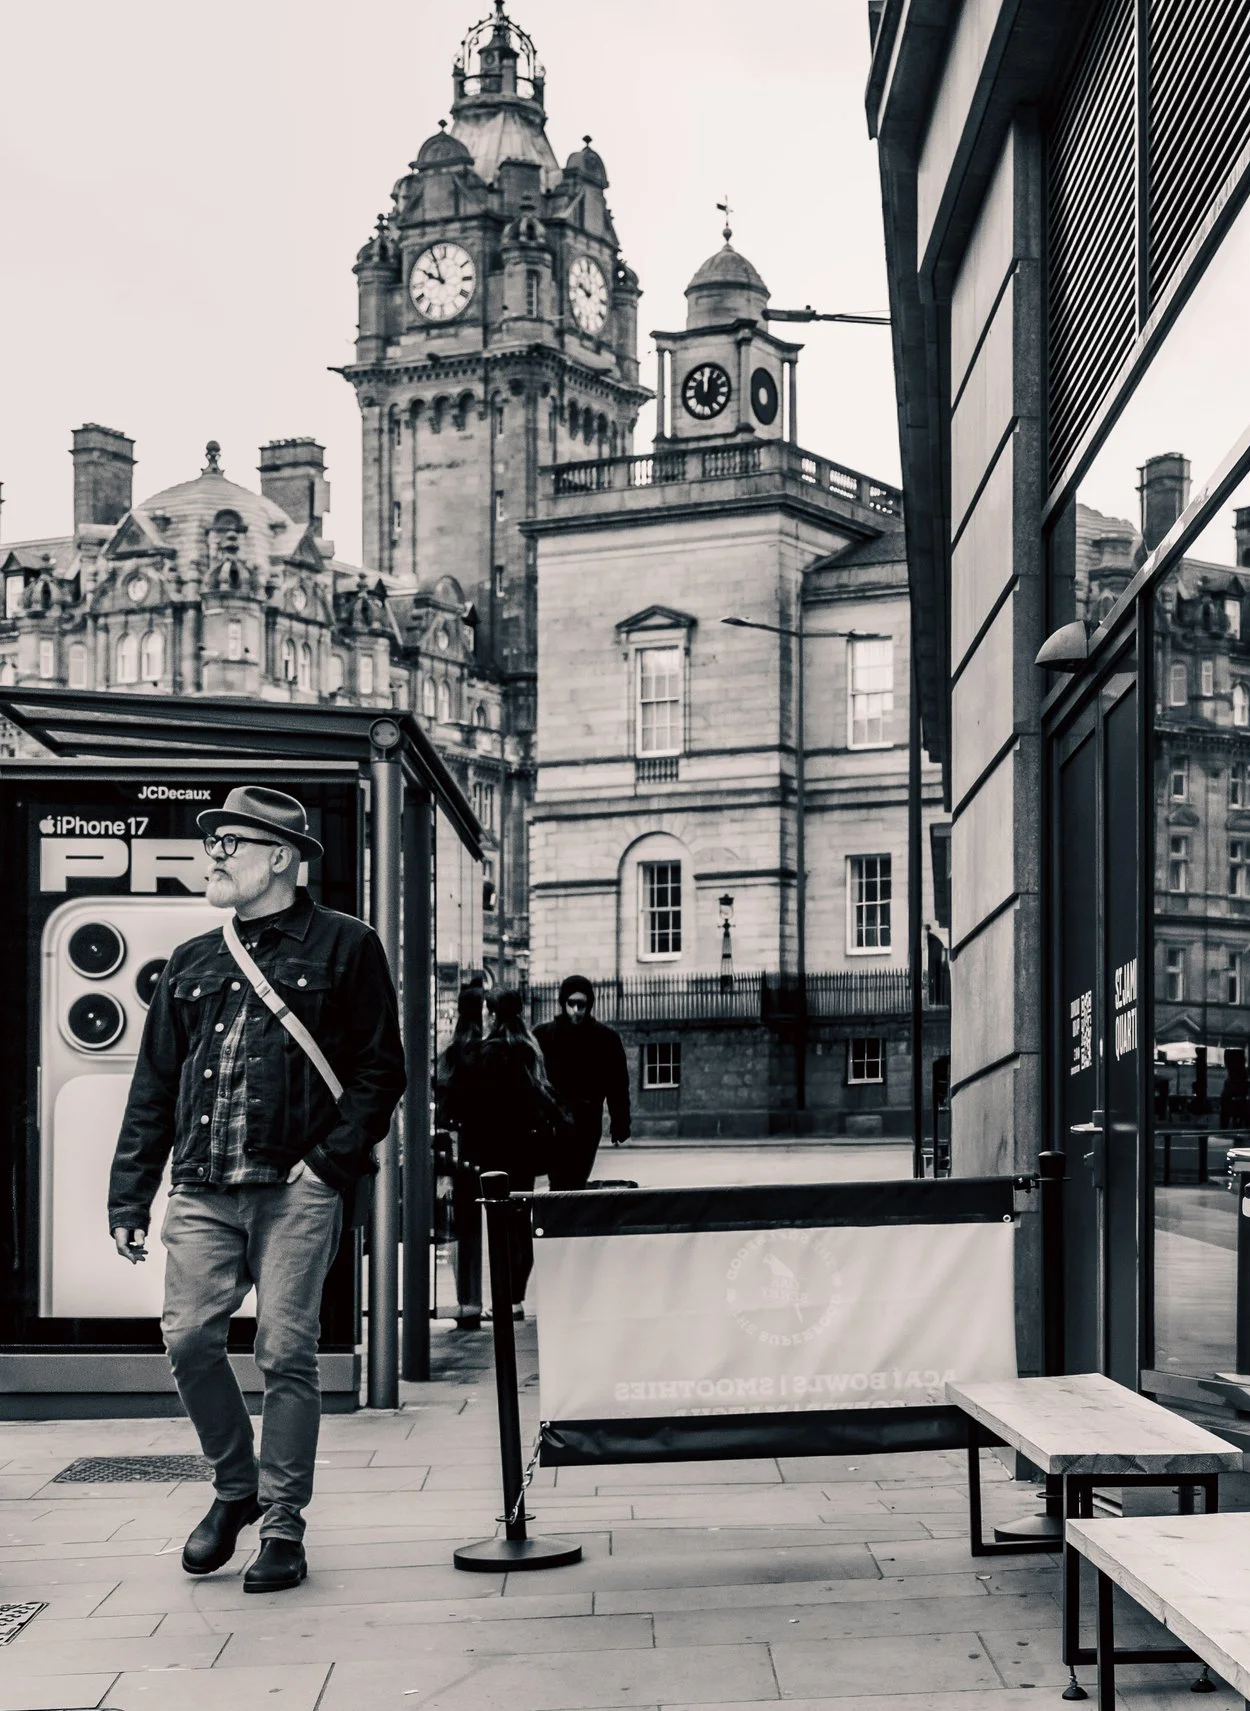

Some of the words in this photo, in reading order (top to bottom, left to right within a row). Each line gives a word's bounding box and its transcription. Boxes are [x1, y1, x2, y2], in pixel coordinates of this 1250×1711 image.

[138, 786, 211, 801] JCDecaux
[57, 816, 126, 835] iPhone
[127, 817, 149, 835] 17
